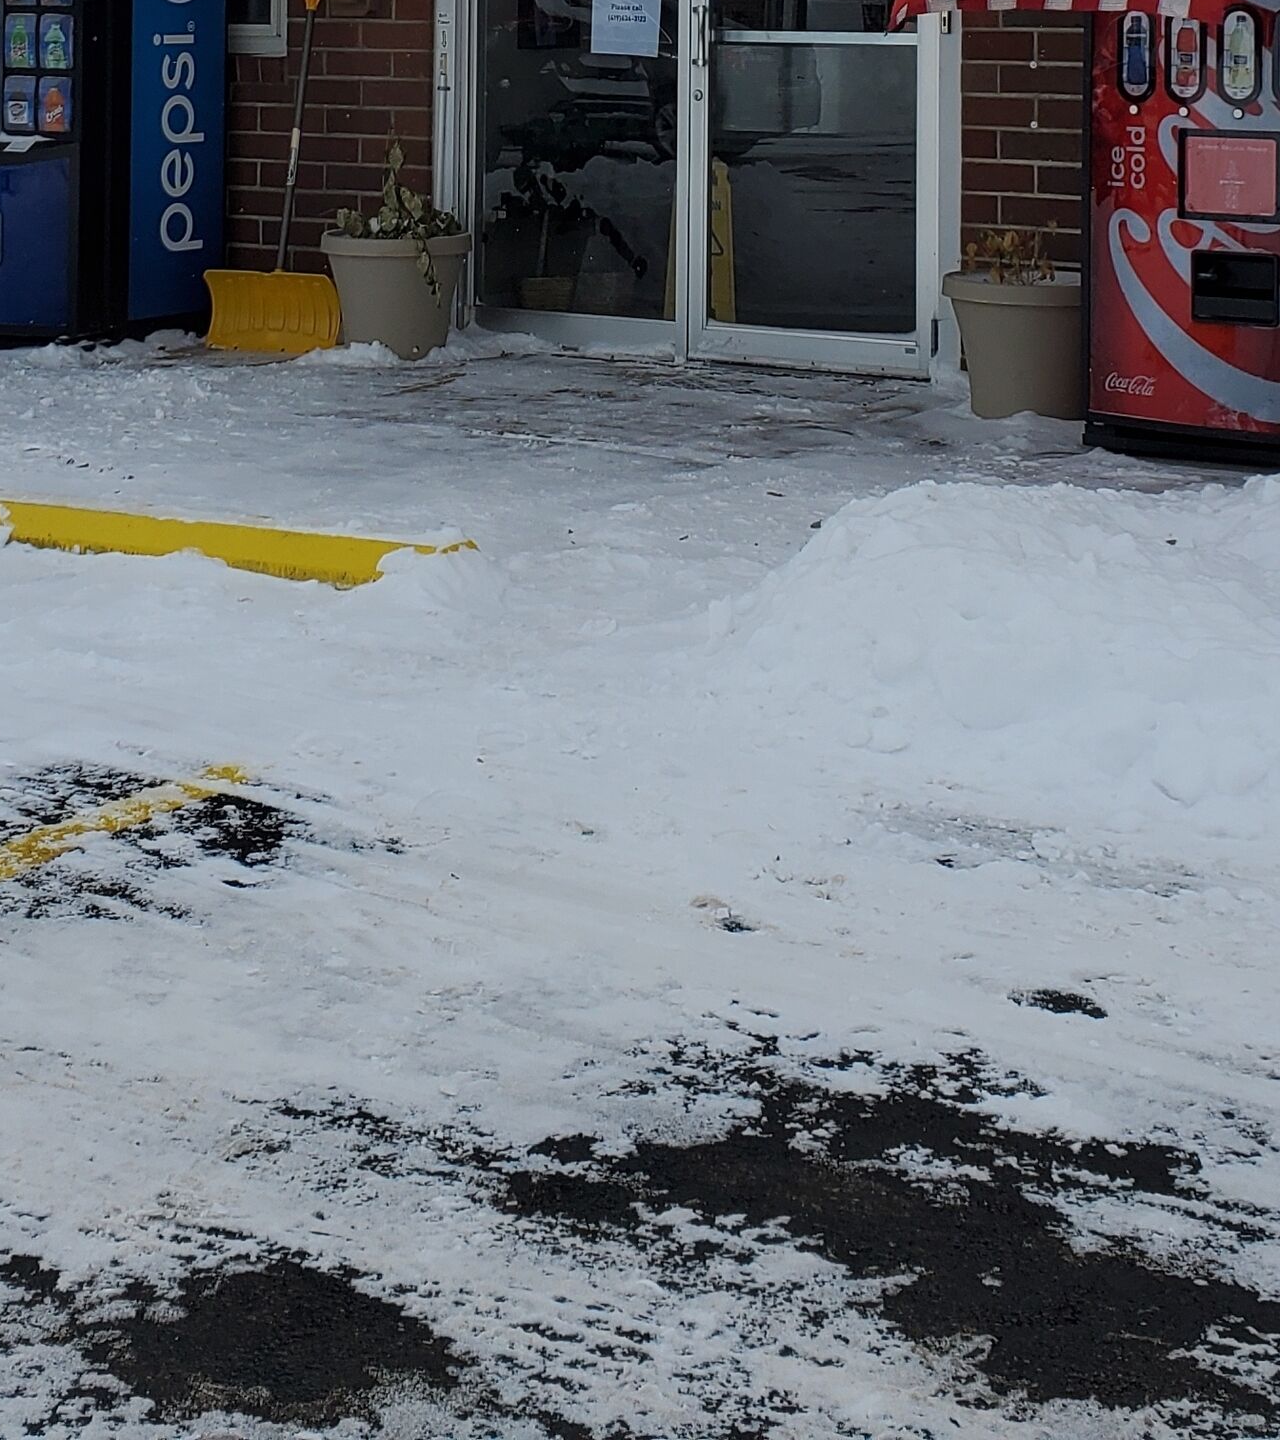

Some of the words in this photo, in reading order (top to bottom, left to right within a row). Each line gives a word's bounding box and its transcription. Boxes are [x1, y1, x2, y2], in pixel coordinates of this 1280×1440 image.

[153, 34, 205, 252] pepsi
[1107, 146, 1126, 188] ice
[1126, 126, 1146, 190] cold
